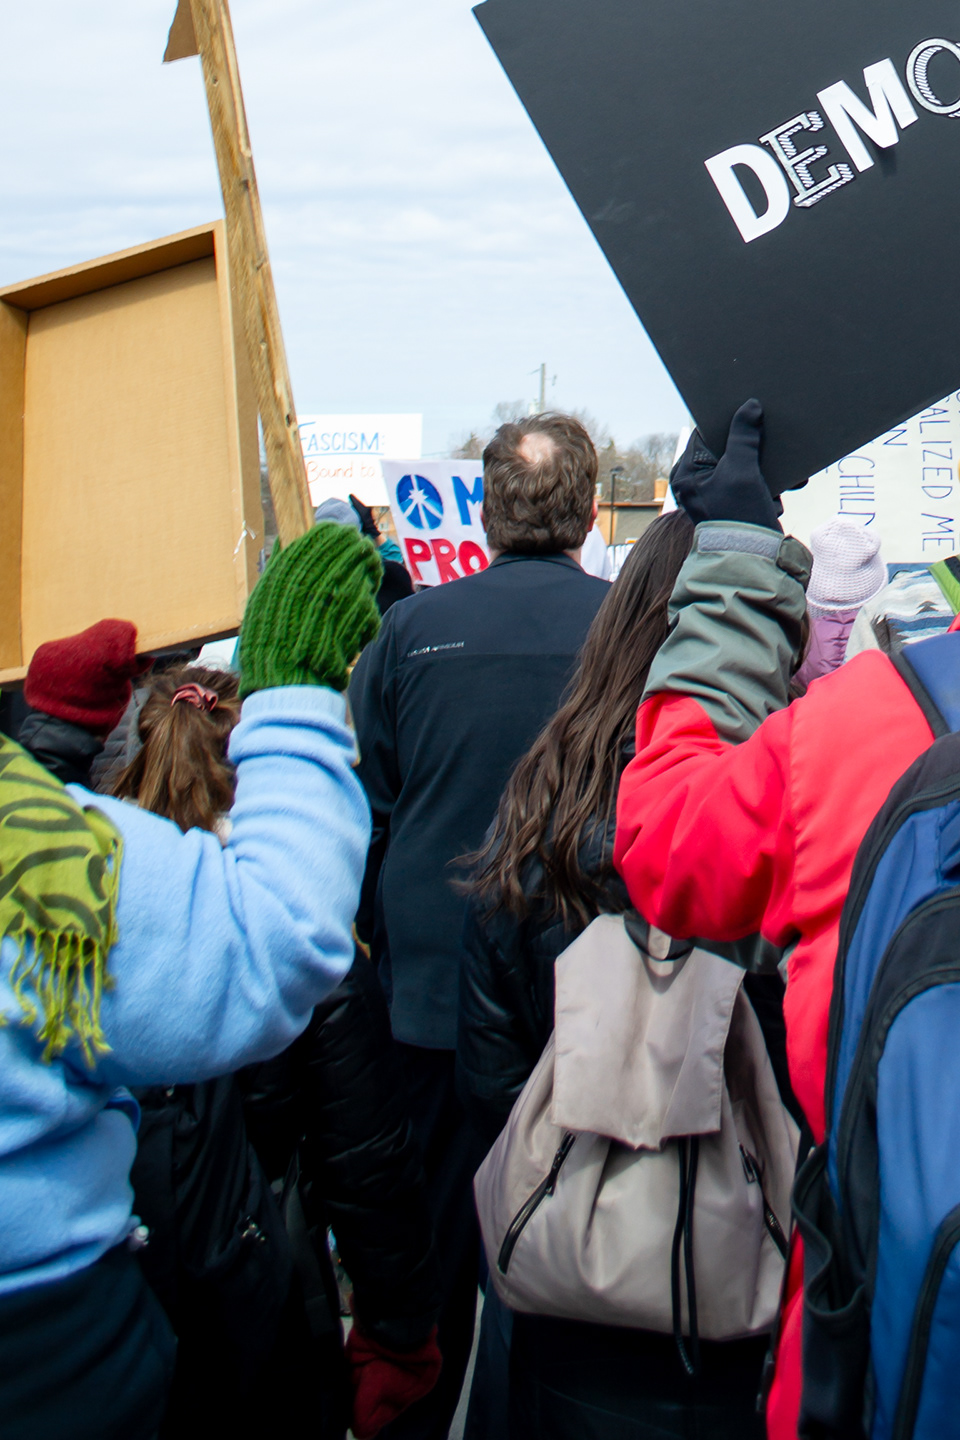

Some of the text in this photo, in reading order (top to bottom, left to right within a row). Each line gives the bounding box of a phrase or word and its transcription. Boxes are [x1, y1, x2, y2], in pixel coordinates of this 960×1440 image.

[306, 460, 376, 483] Bound to
[920, 512, 955, 552] ME
